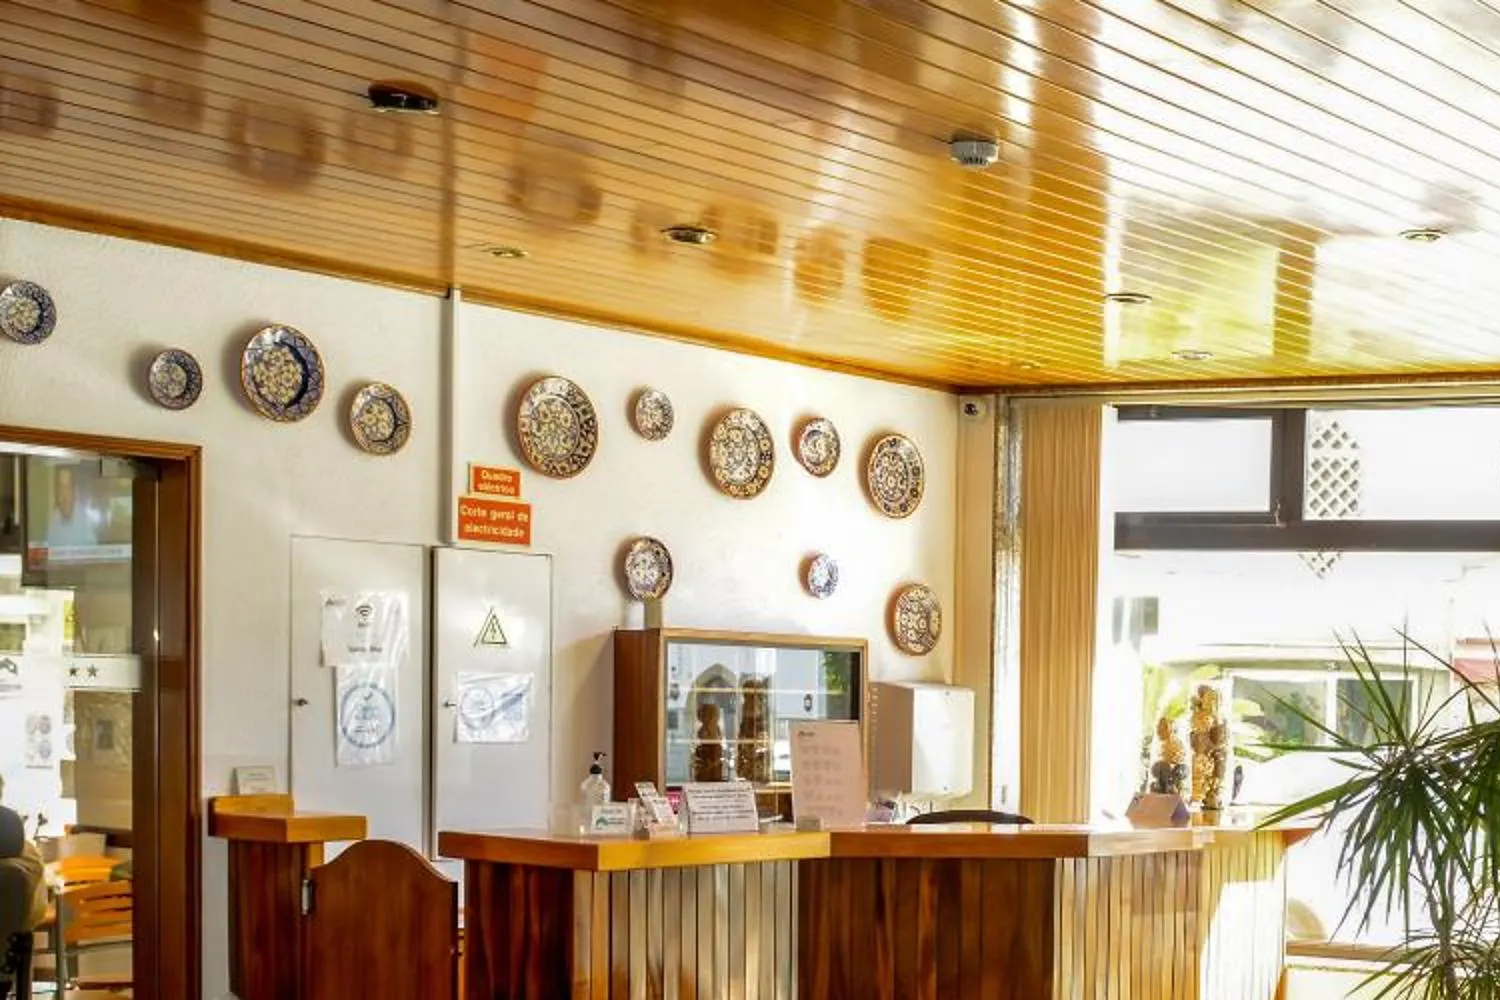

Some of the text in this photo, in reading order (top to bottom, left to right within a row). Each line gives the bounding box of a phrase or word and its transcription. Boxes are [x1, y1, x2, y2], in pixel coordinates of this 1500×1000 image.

[480, 470, 513, 482] Quadro
[460, 505, 529, 522] Corte geral de
[464, 523, 525, 537] electricidade
